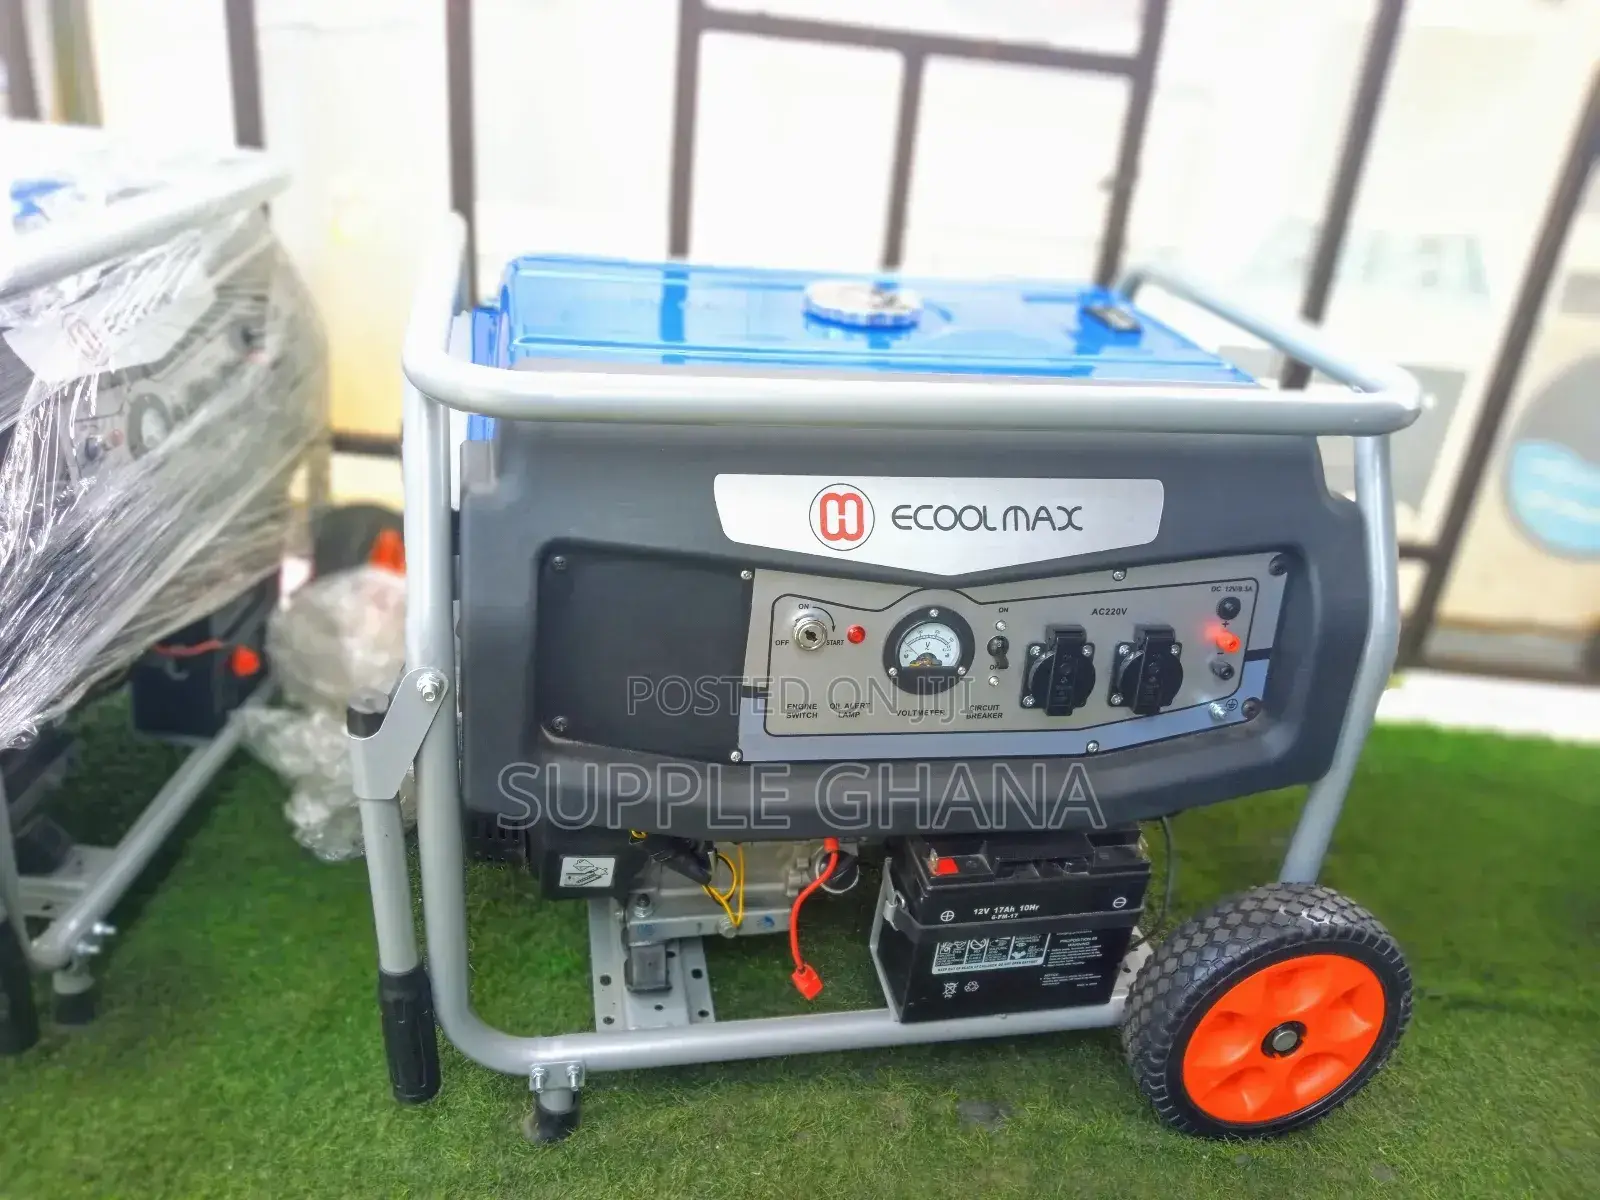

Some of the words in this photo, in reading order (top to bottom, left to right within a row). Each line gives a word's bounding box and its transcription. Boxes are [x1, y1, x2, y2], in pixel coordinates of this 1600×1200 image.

[1091, 607, 1128, 616] AC220V
[970, 704, 1000, 712] CIRCUIT
[966, 712, 1003, 720] BREAKER
[973, 907, 990, 915] 12V
[994, 905, 1015, 914] 17Ah
[1020, 903, 1039, 912] 10Hr
